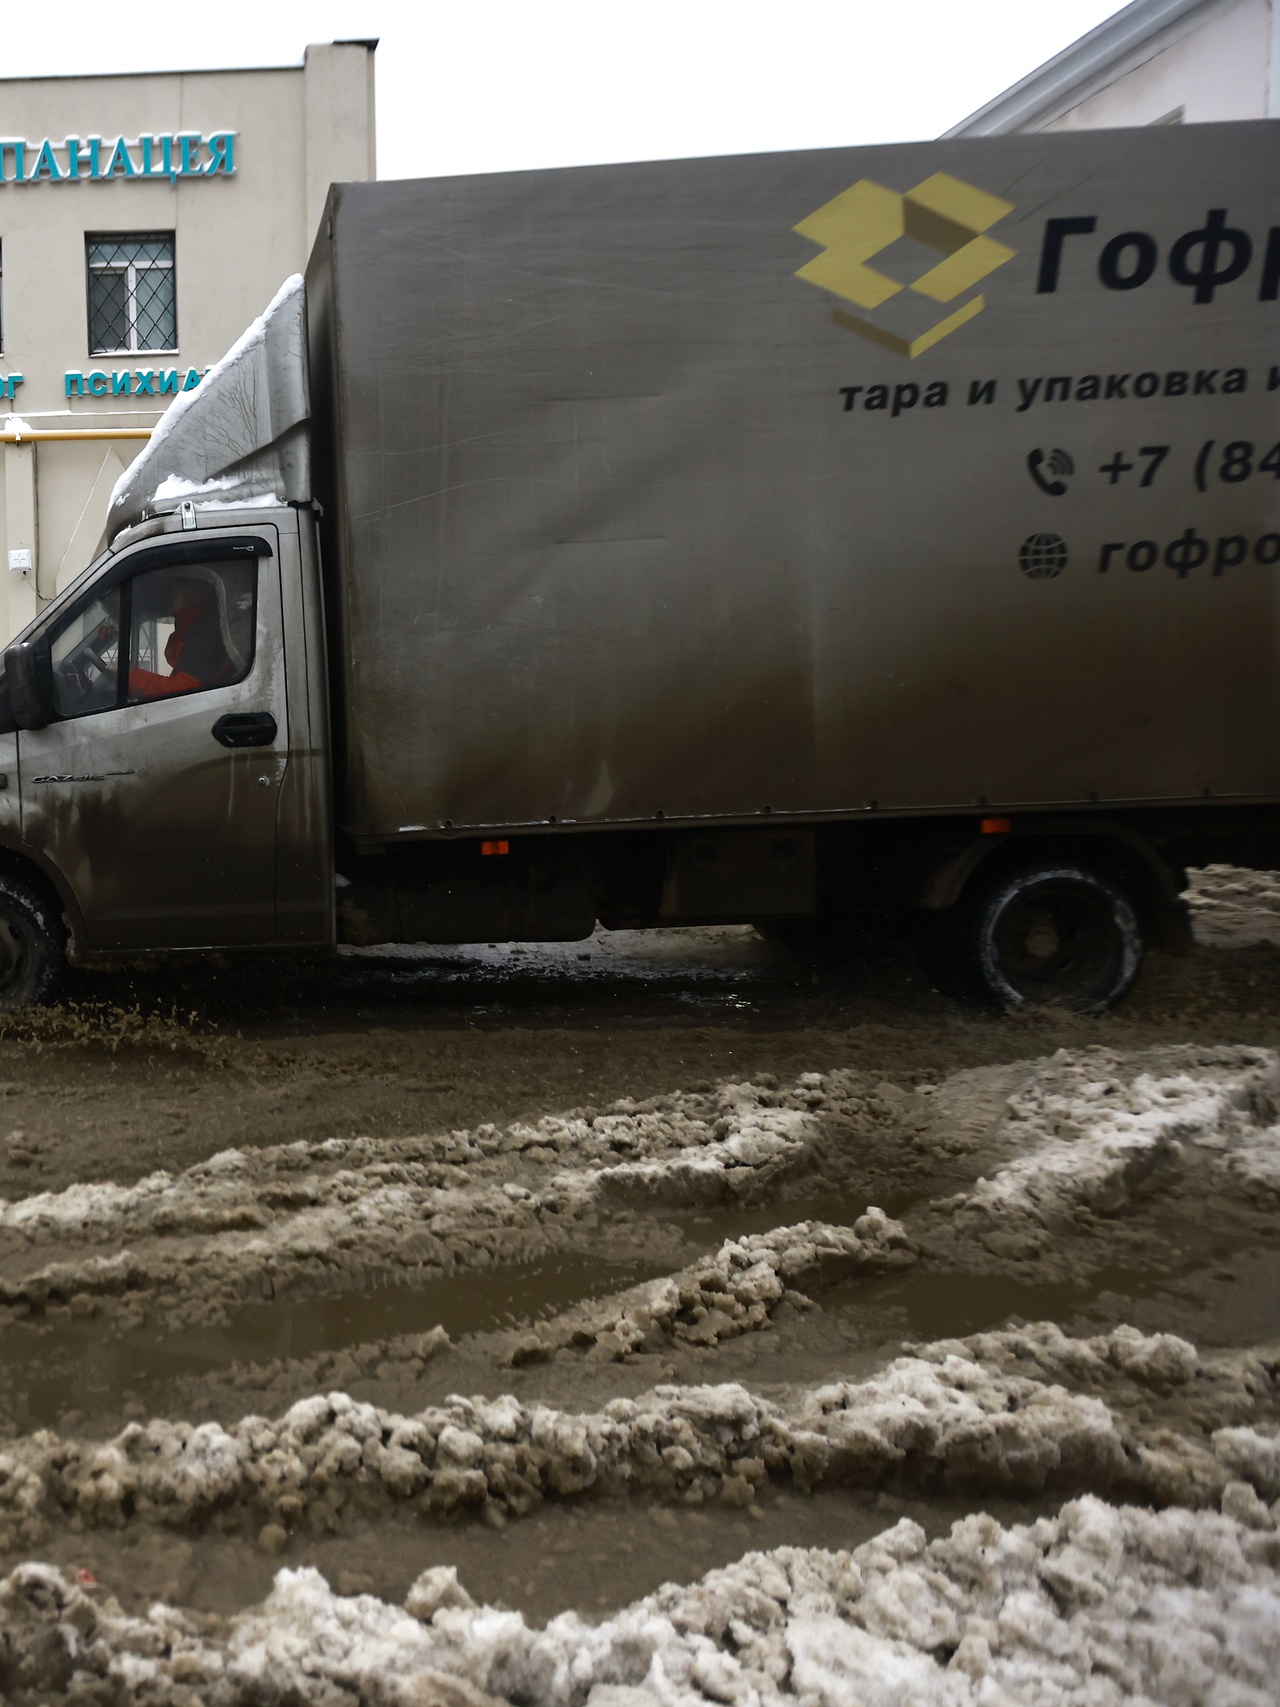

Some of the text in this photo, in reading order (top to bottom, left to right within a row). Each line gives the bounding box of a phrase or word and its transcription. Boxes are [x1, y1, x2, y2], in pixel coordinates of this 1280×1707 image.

[64, 367, 213, 398] ПСИХИА
[839, 381, 949, 416] тара
[967, 378, 998, 406] и
[1015, 366, 1248, 413] упаковка
[1098, 445, 1170, 488] +7
[1097, 528, 1280, 580] гофро
